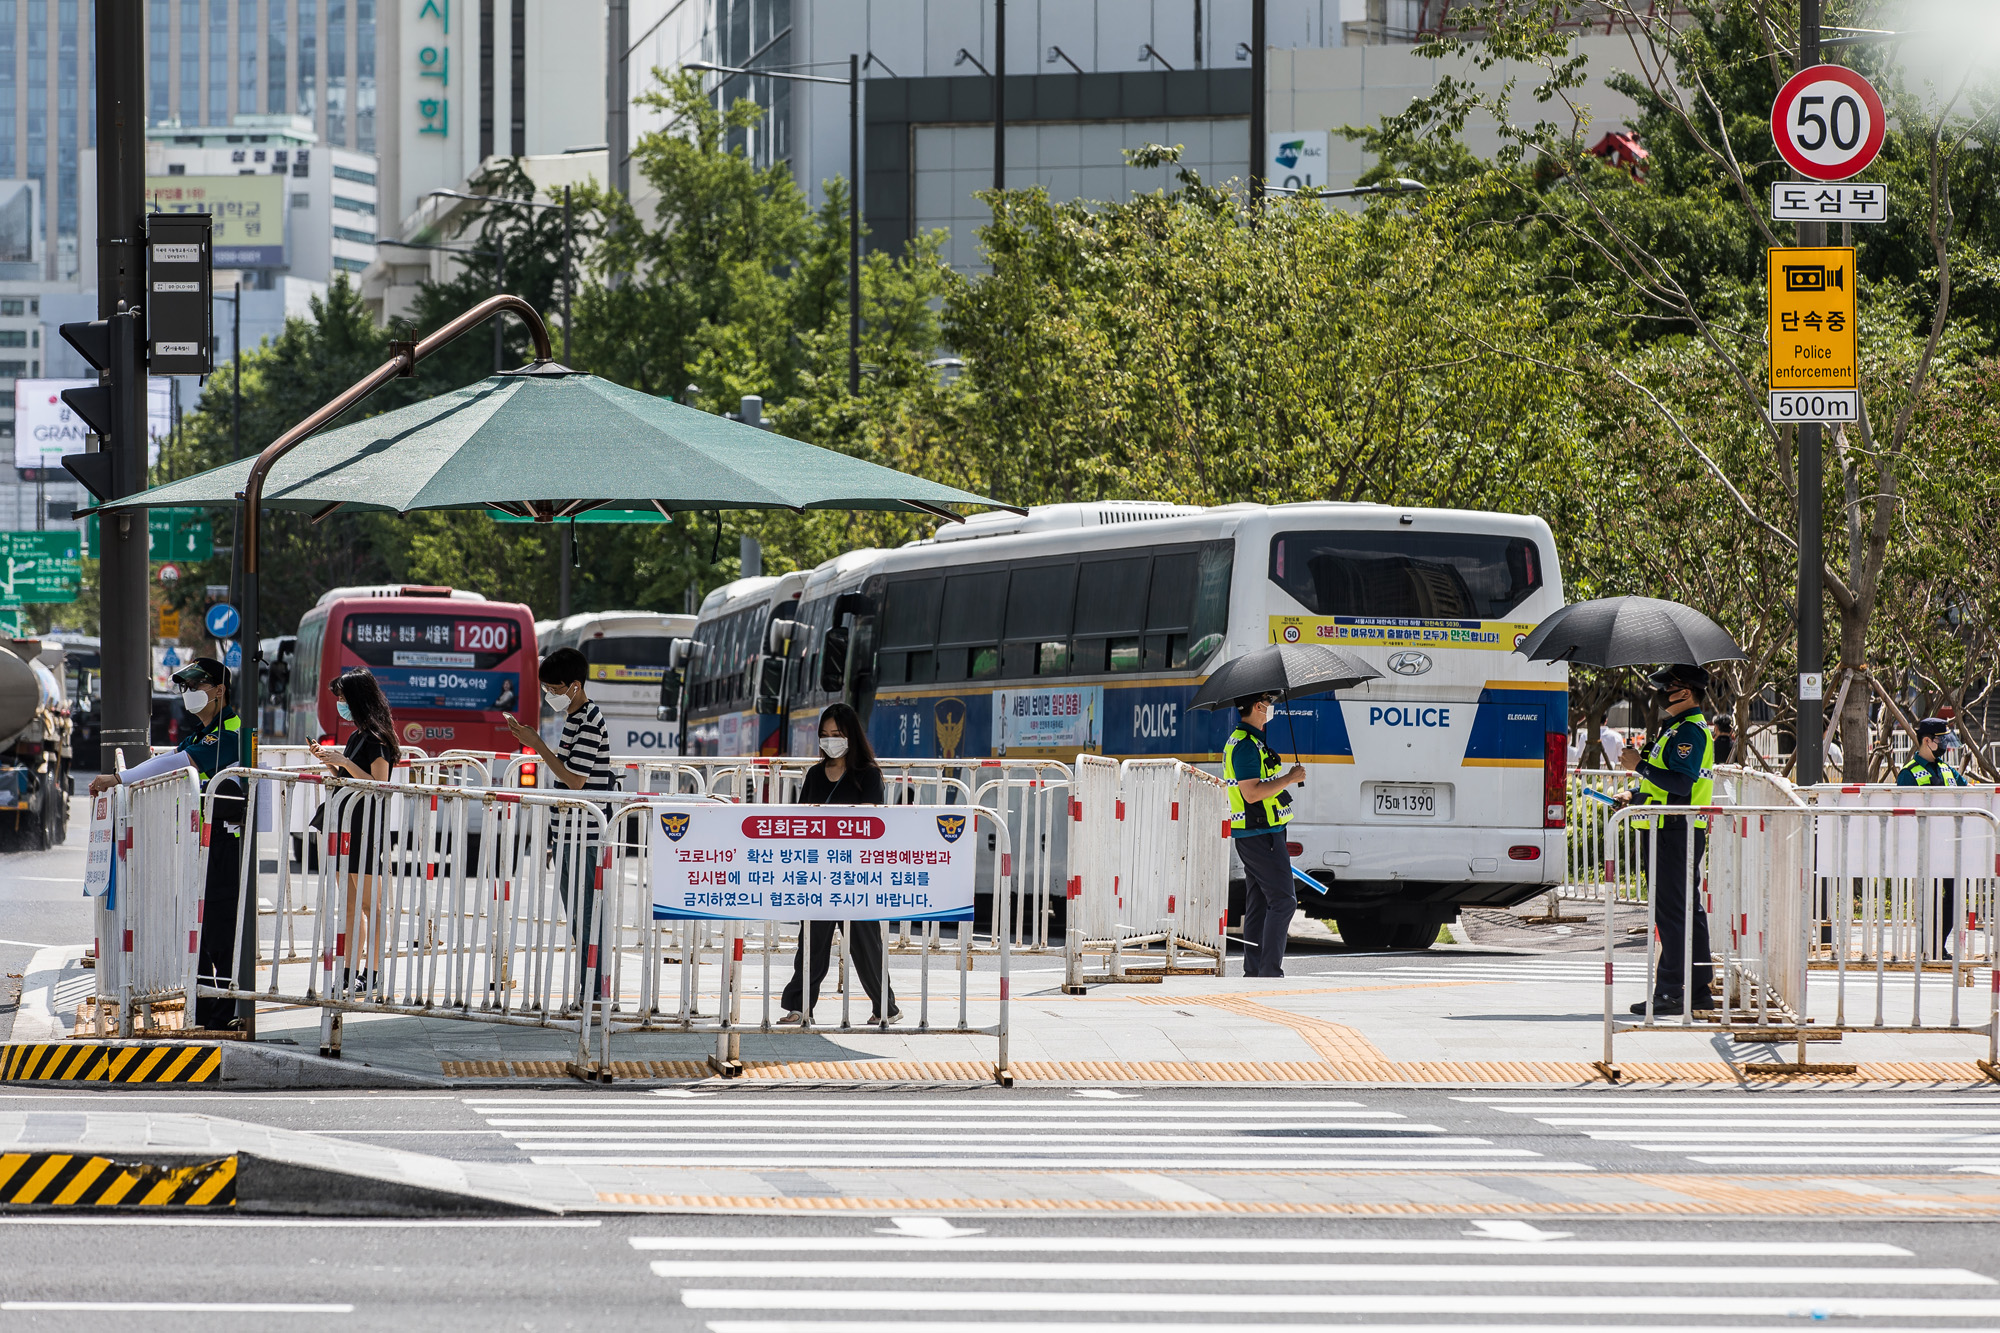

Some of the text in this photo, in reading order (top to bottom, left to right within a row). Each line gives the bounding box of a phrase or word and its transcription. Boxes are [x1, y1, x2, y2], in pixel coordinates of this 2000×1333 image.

[1797, 95, 1861, 151] 50
[1780, 188, 1879, 214] 도심부
[1780, 310, 1847, 332] 단속중
[1794, 344, 1832, 359] Police
[1775, 365, 1852, 378] enforcement
[1779, 396, 1850, 417] 500m
[425, 625, 450, 645] 서울역
[457, 624, 508, 650] 1200
[1287, 630, 1298, 639] 50
[1316, 625, 1500, 643] 3분!만 여유있게 출발하면 모두가 안전합니다!
[408, 675, 436, 688] 취업률
[1012, 693, 1082, 717] 사람이 보이면 일단 멈춤!
[1133, 703, 1177, 738] POLICE
[1369, 706, 1450, 728] POLICE
[1507, 713, 1538, 721] ELEGANCE
[425, 727, 455, 740] BUS
[756, 818, 871, 837] 집회금지 안내
[746, 848, 774, 864] 확산
[780, 848, 820, 864] 방지를
[826, 848, 853, 864] 위해
[859, 849, 952, 865] 감염병예방법과
[687, 870, 741, 886] 집시법에
[748, 870, 775, 886] 따라
[890, 871, 930, 887] 집회를
[683, 892, 933, 908] 금지하였으니 협조하여 주시기 바랍니다.
